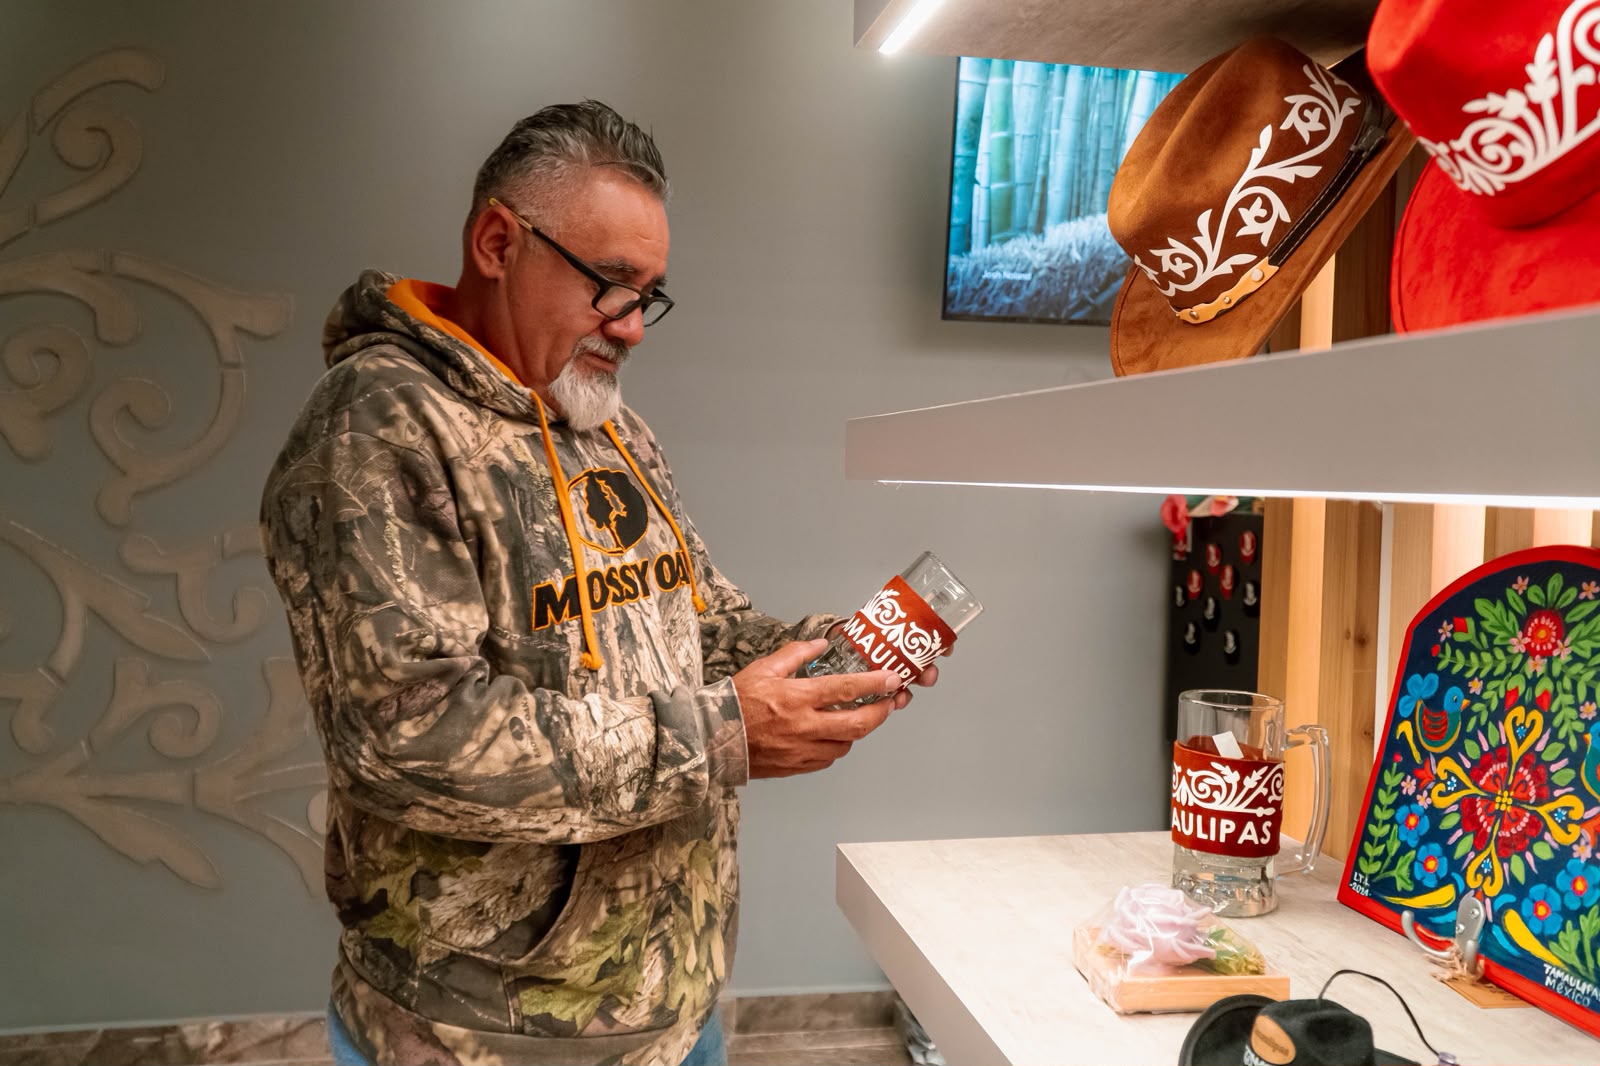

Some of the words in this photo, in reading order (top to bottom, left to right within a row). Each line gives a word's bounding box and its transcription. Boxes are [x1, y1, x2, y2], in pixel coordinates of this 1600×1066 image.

[532, 558, 651, 631] MOSSY
[1172, 807, 1273, 846] AULIPAS
[1543, 963, 1600, 1003] TAMAULIPA
